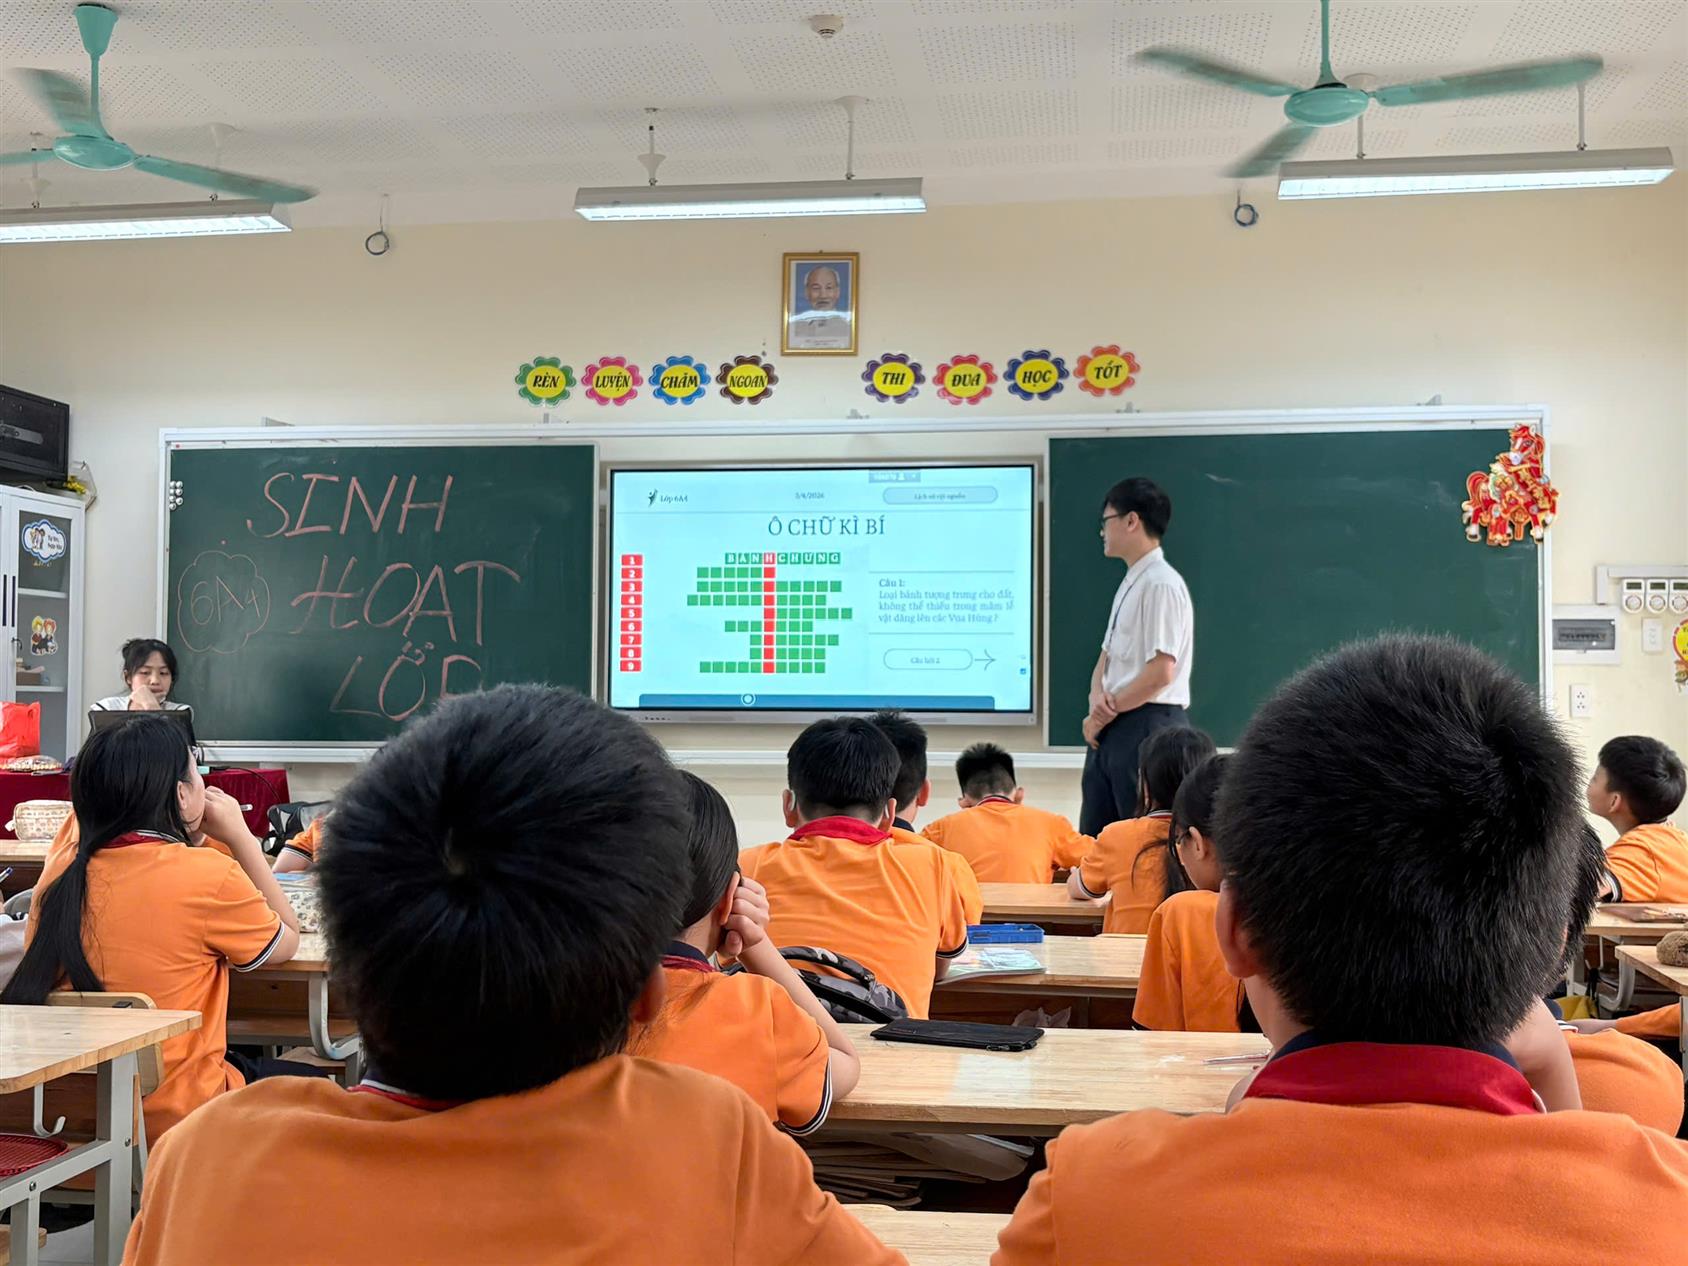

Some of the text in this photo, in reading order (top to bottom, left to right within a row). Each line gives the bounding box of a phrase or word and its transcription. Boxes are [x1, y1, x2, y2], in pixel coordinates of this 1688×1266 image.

[533, 371, 559, 388] RÈN
[729, 375, 767, 388] NGOAN
[882, 360, 1123, 387] THI ĐUA HỌC TỐT
[246, 472, 454, 538] SINH
[768, 514, 885, 536] Ô CHỮ KÌ BÍ
